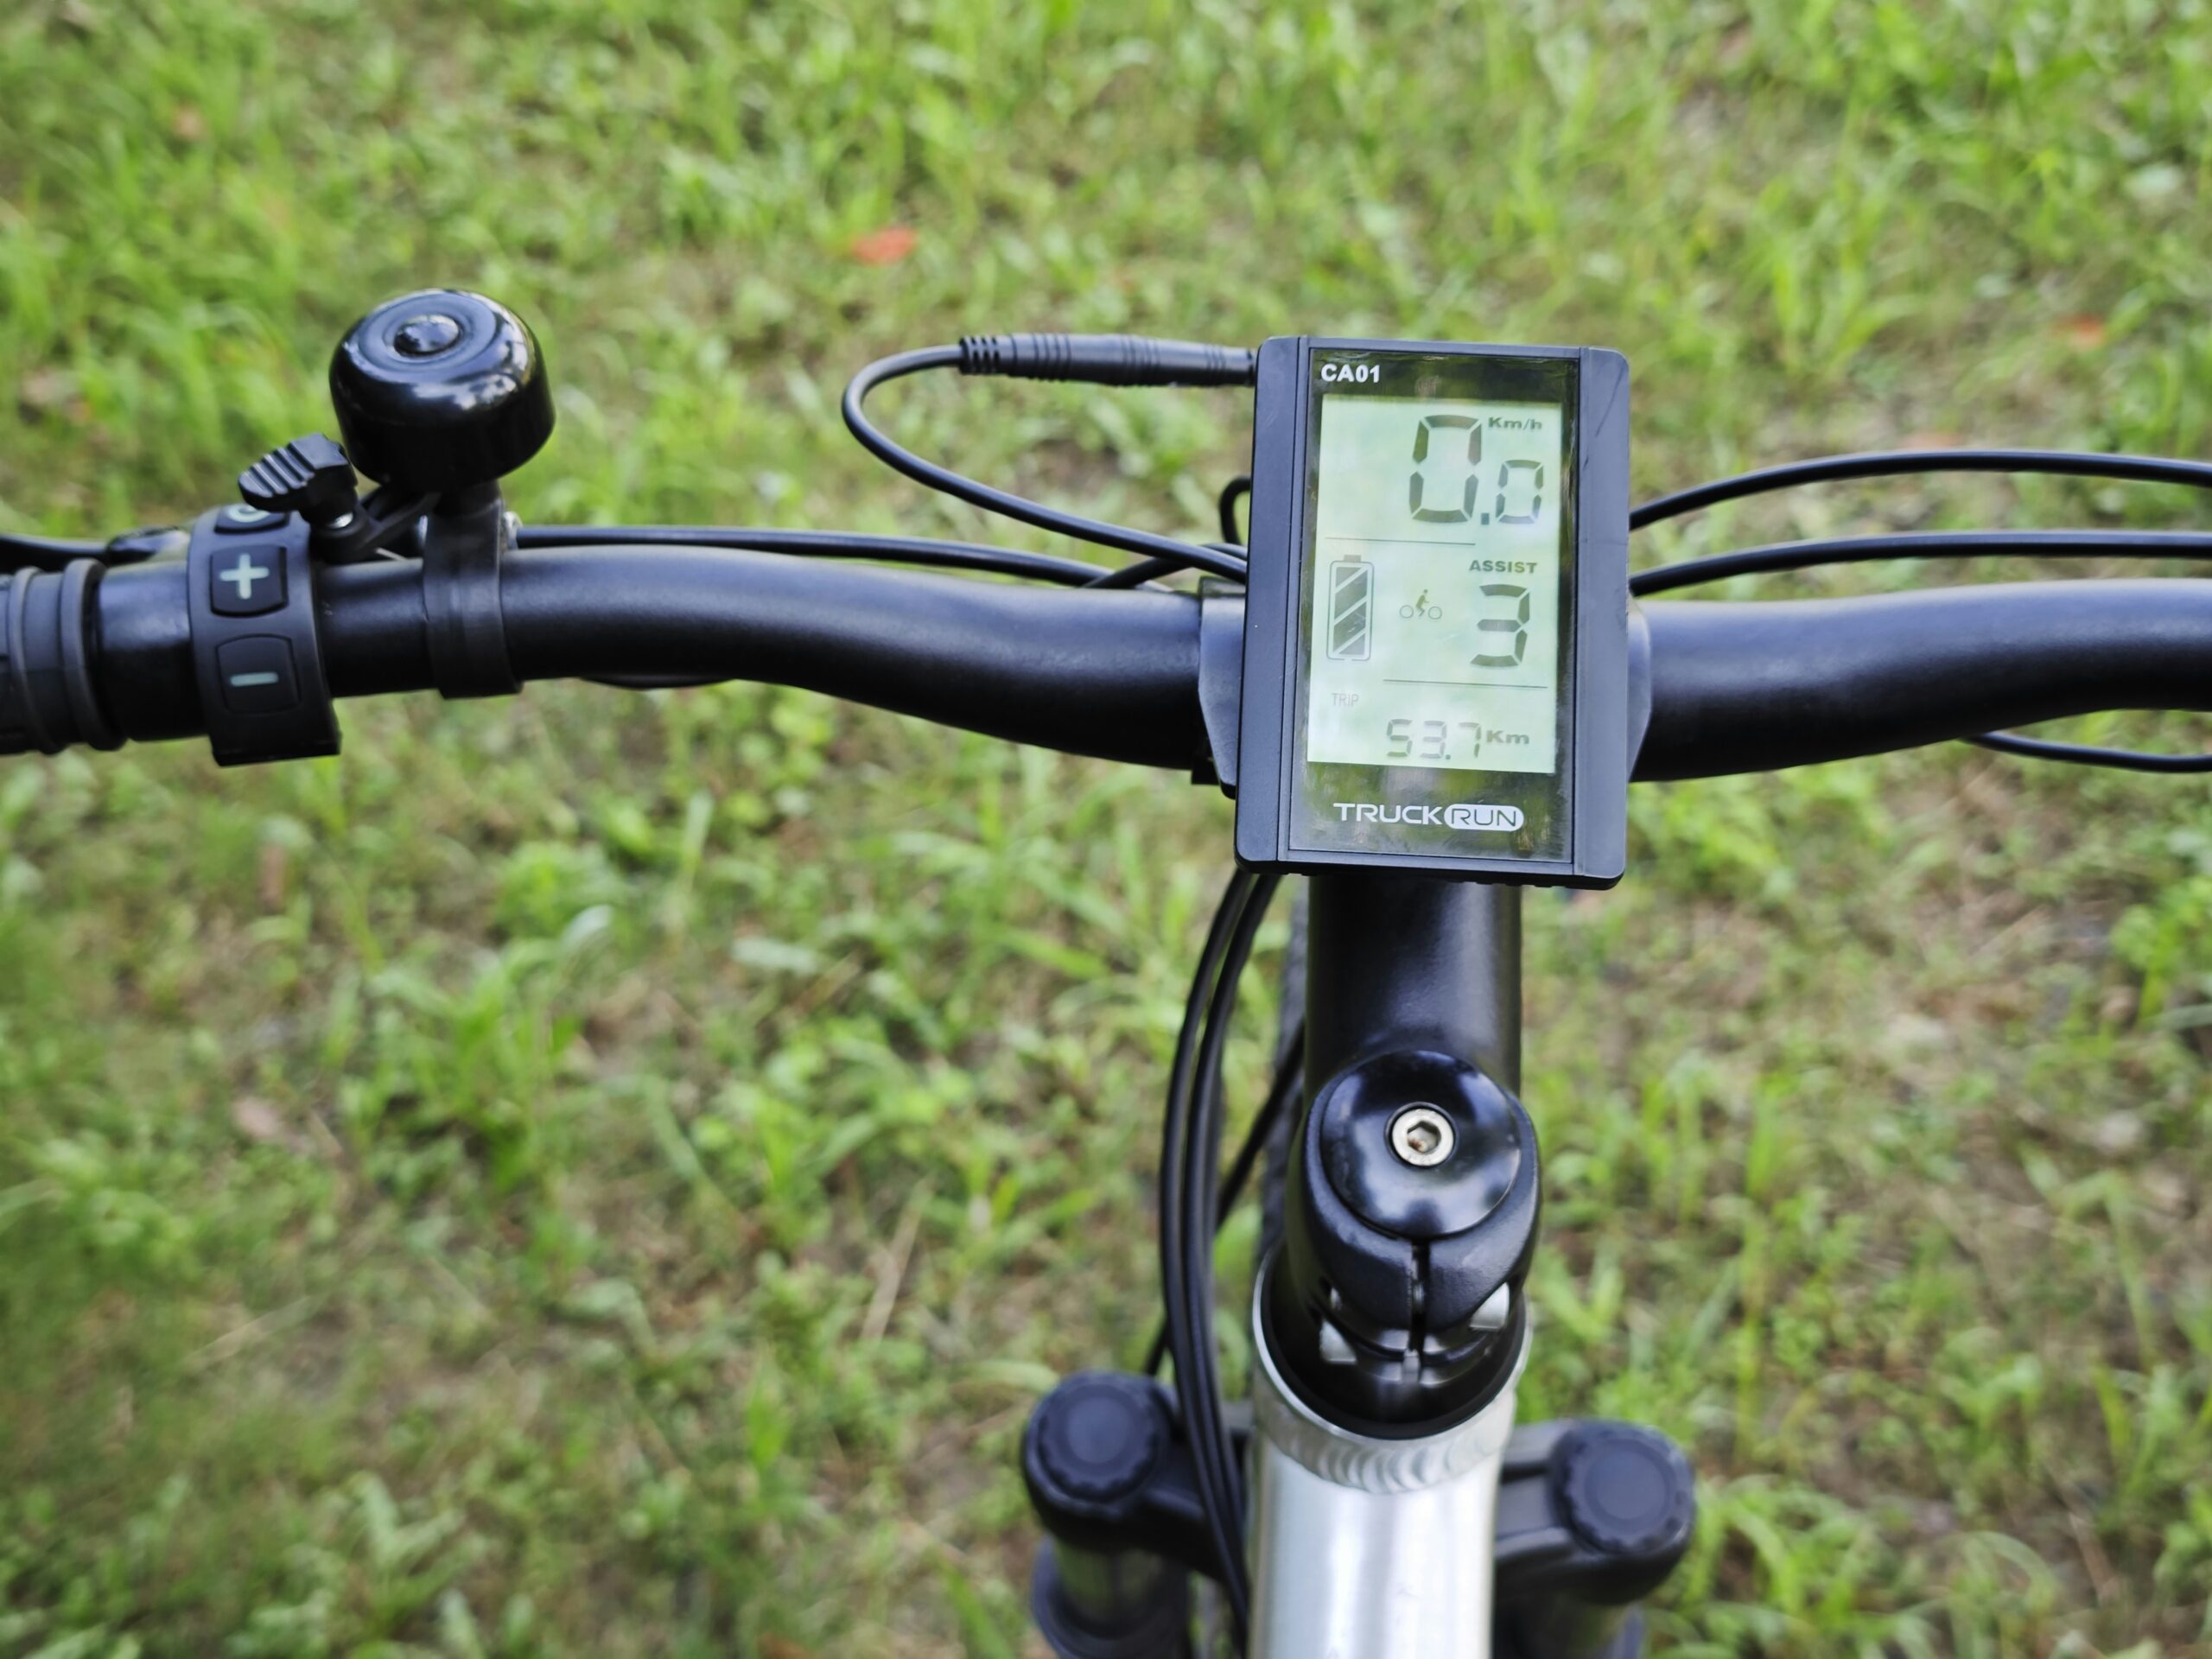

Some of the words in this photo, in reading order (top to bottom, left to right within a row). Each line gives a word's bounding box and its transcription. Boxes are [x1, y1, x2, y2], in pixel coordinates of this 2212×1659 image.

[1320, 363, 1381, 384] CA01
[1408, 415, 1544, 525] 0.0
[1488, 416, 1542, 431] Km/h
[1469, 559, 1538, 574] ASSIST
[1471, 584, 1530, 667] 3
[1332, 692, 1359, 708] TRIP
[1386, 718, 1481, 760] 53.7
[1486, 730, 1529, 746] Km
